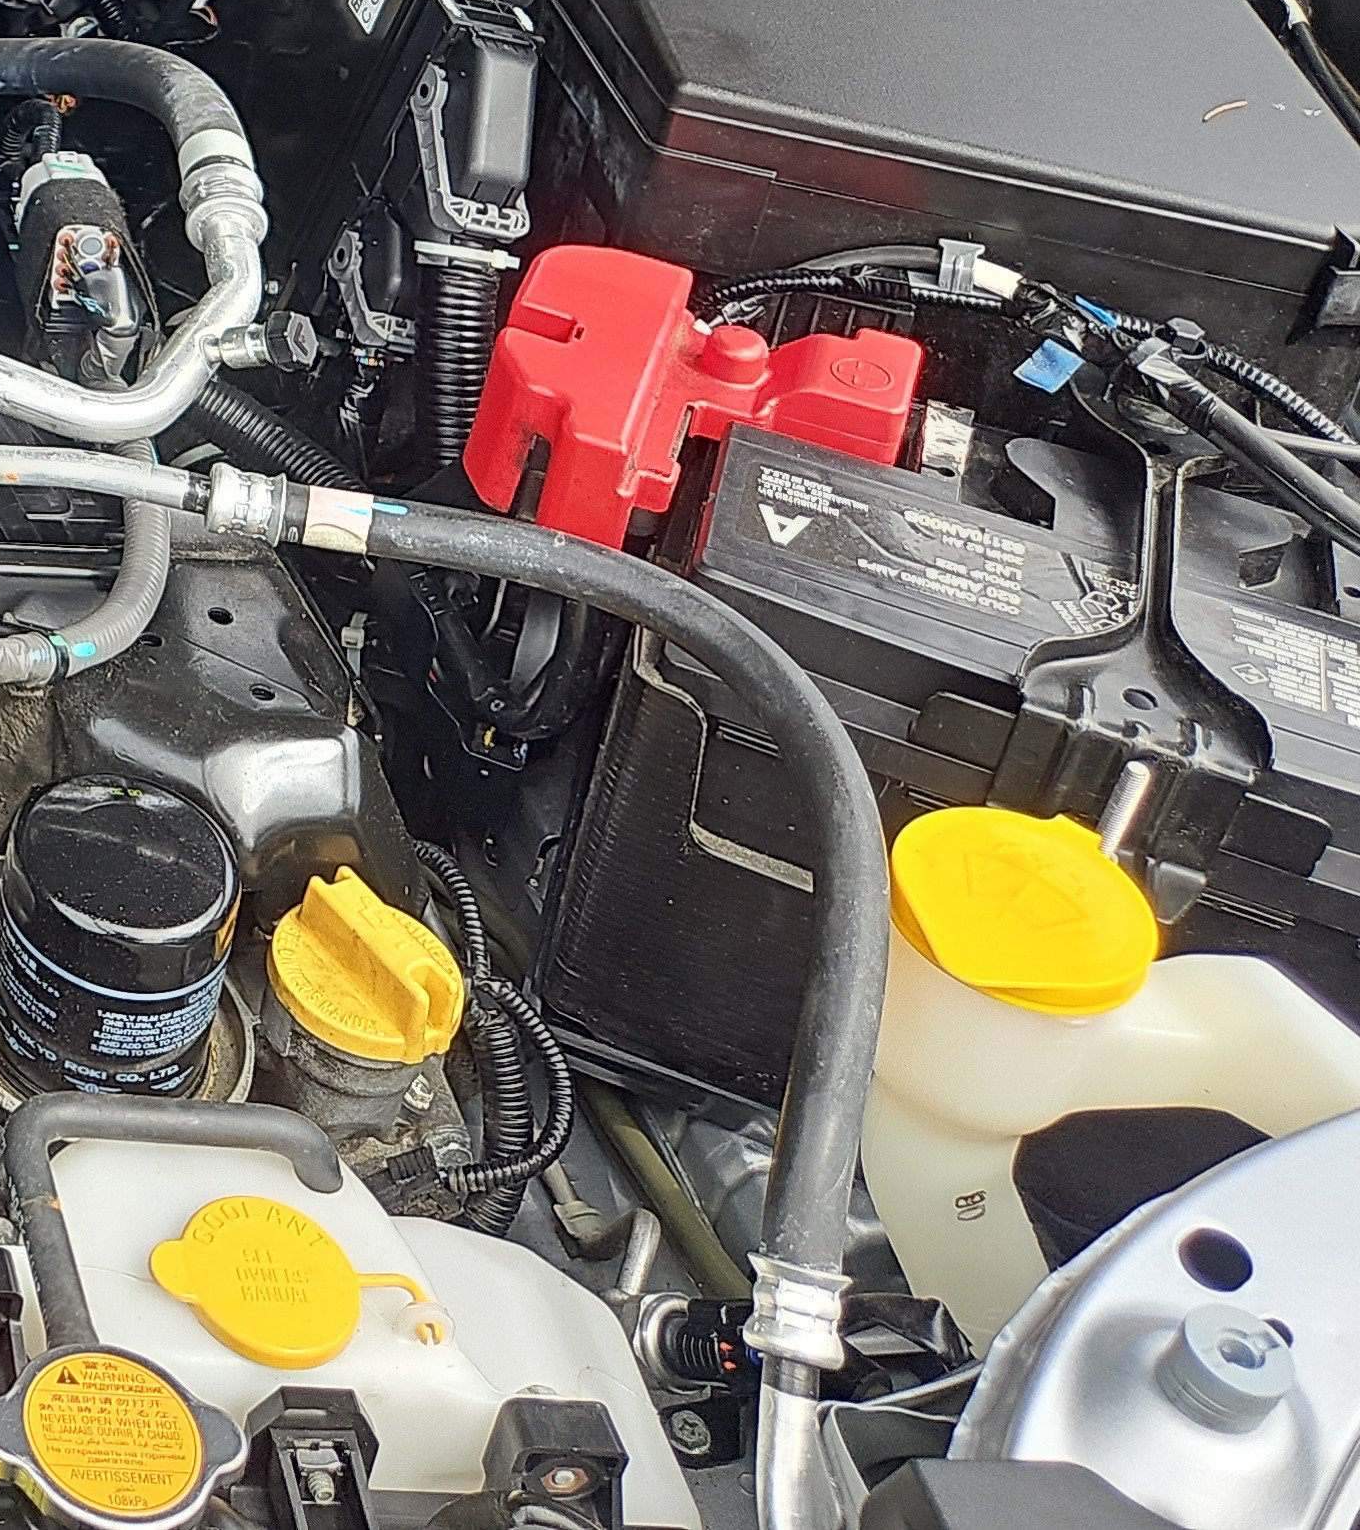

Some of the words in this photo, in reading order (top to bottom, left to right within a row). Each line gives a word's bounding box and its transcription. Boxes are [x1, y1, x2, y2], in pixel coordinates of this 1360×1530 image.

[11, 1019, 58, 1062] TOKYO
[64, 1059, 108, 1080] ROKI
[193, 1201, 330, 1248] COOLANT
[80, 1371, 145, 1383] WARNING
[40, 1413, 77, 1424] NEVER
[81, 1416, 112, 1426] OPEN
[116, 1418, 151, 1429] WHEN
[155, 1421, 182, 1431] HOT.
[43, 1424, 54, 1433] NE
[59, 1424, 93, 1436] JAMAIS
[97, 1426, 133, 1438] OUVRIR
[70, 1468, 174, 1485] AVERTISSEMENT
[108, 1494, 148, 1507] 108kPa
